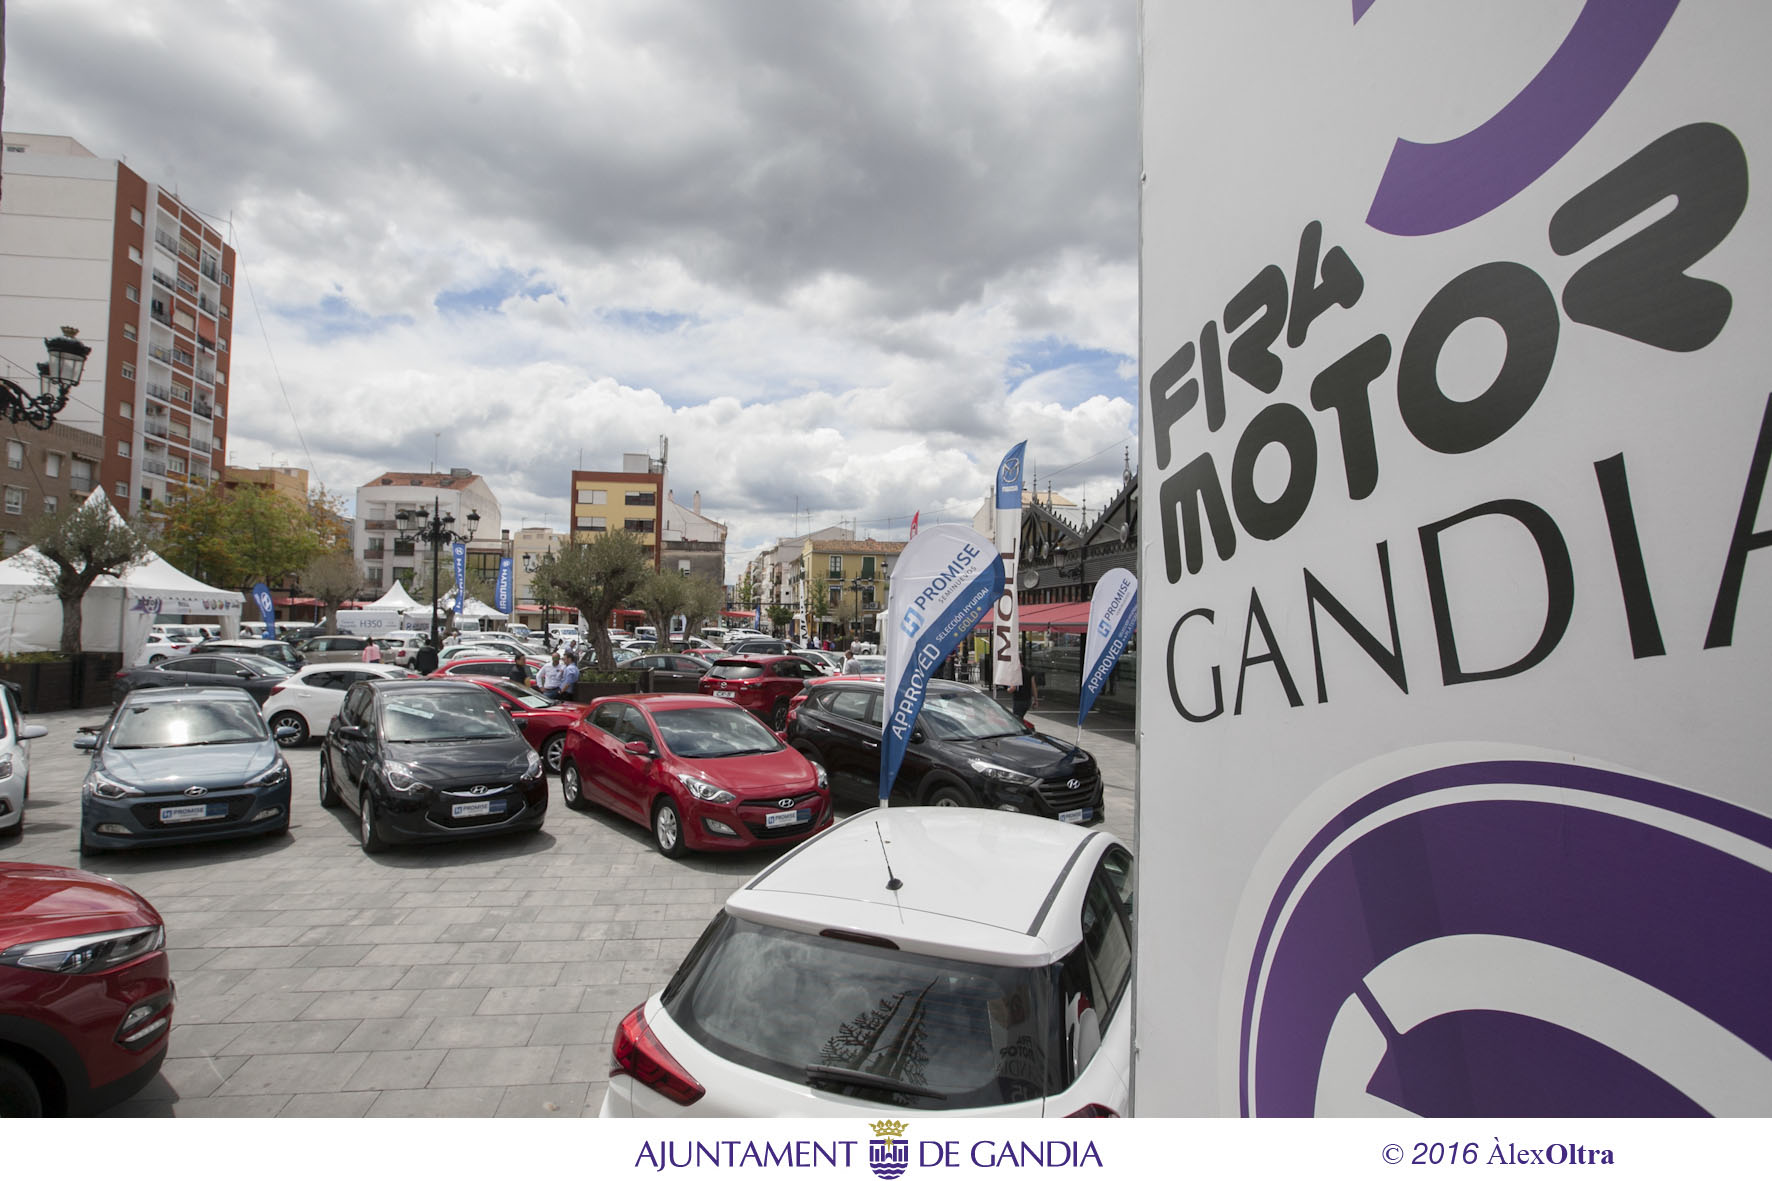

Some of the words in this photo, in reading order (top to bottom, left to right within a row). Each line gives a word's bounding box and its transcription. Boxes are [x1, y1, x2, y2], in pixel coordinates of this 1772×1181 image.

[1150, 220, 1364, 470] FIRA
[1160, 122, 1749, 584] MOTOR
[914, 544, 980, 611] PROMISE
[938, 566, 977, 604] SEMINUEVOS
[1104, 578, 1131, 621] PROMISE
[360, 619, 383, 628] H350
[958, 612, 979, 633] GOLD
[892, 643, 941, 740] APPROVED
[1088, 639, 1122, 694] APPROVED
